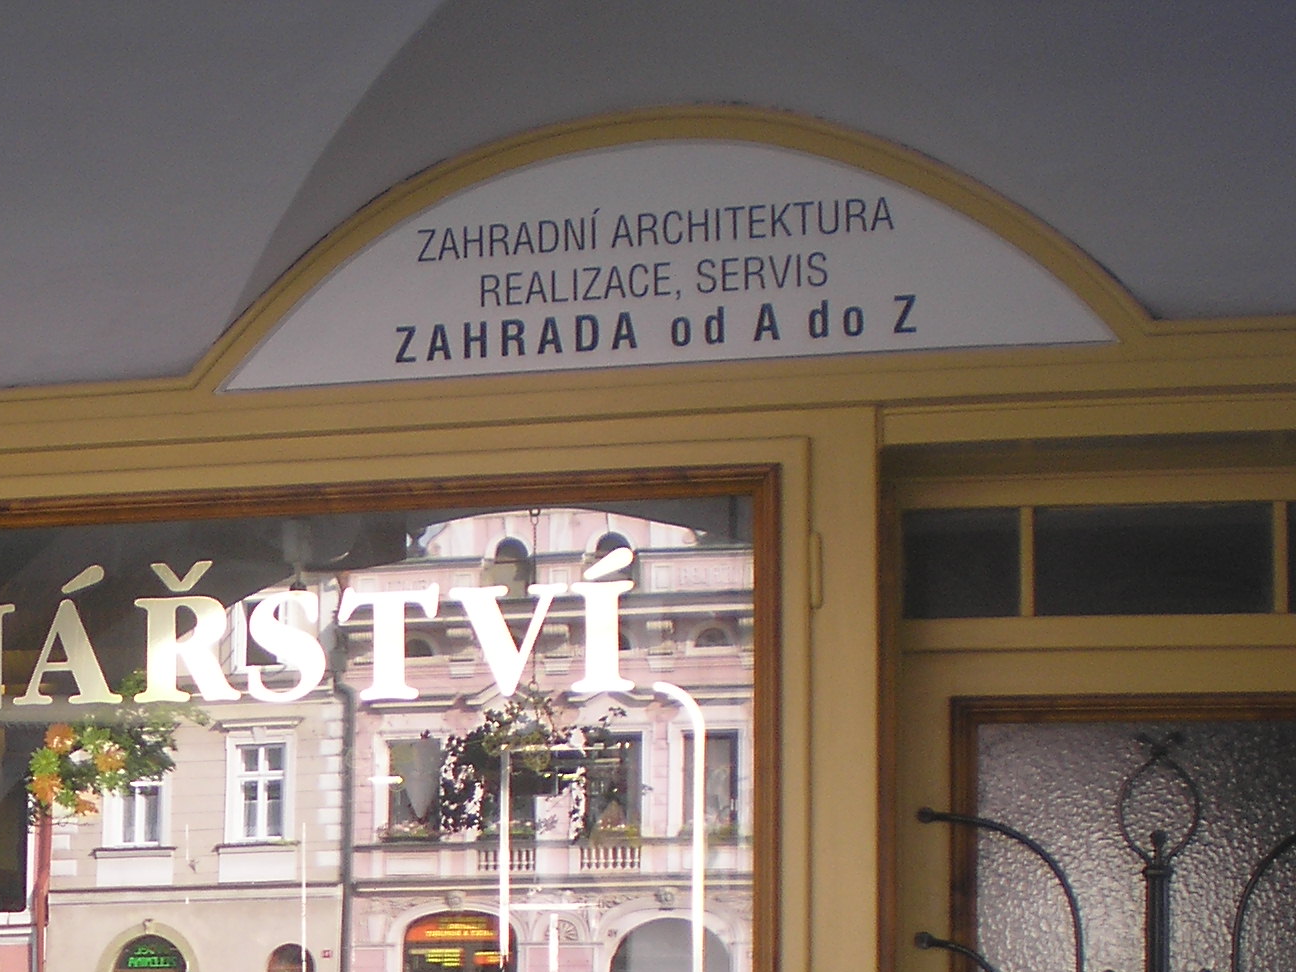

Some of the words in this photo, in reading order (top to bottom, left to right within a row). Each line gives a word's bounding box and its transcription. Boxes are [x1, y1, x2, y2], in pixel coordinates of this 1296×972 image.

[417, 209, 599, 262] ZAHRADNÍ
[610, 197, 895, 250] ARCHITEKTURA
[480, 260, 681, 308] REALIZACE,
[696, 252, 829, 295] SERVIS
[395, 311, 639, 363] ZAHRADA
[671, 306, 726, 347] od
[753, 302, 781, 341] A
[809, 299, 865, 339] do
[893, 294, 918, 334] Z
